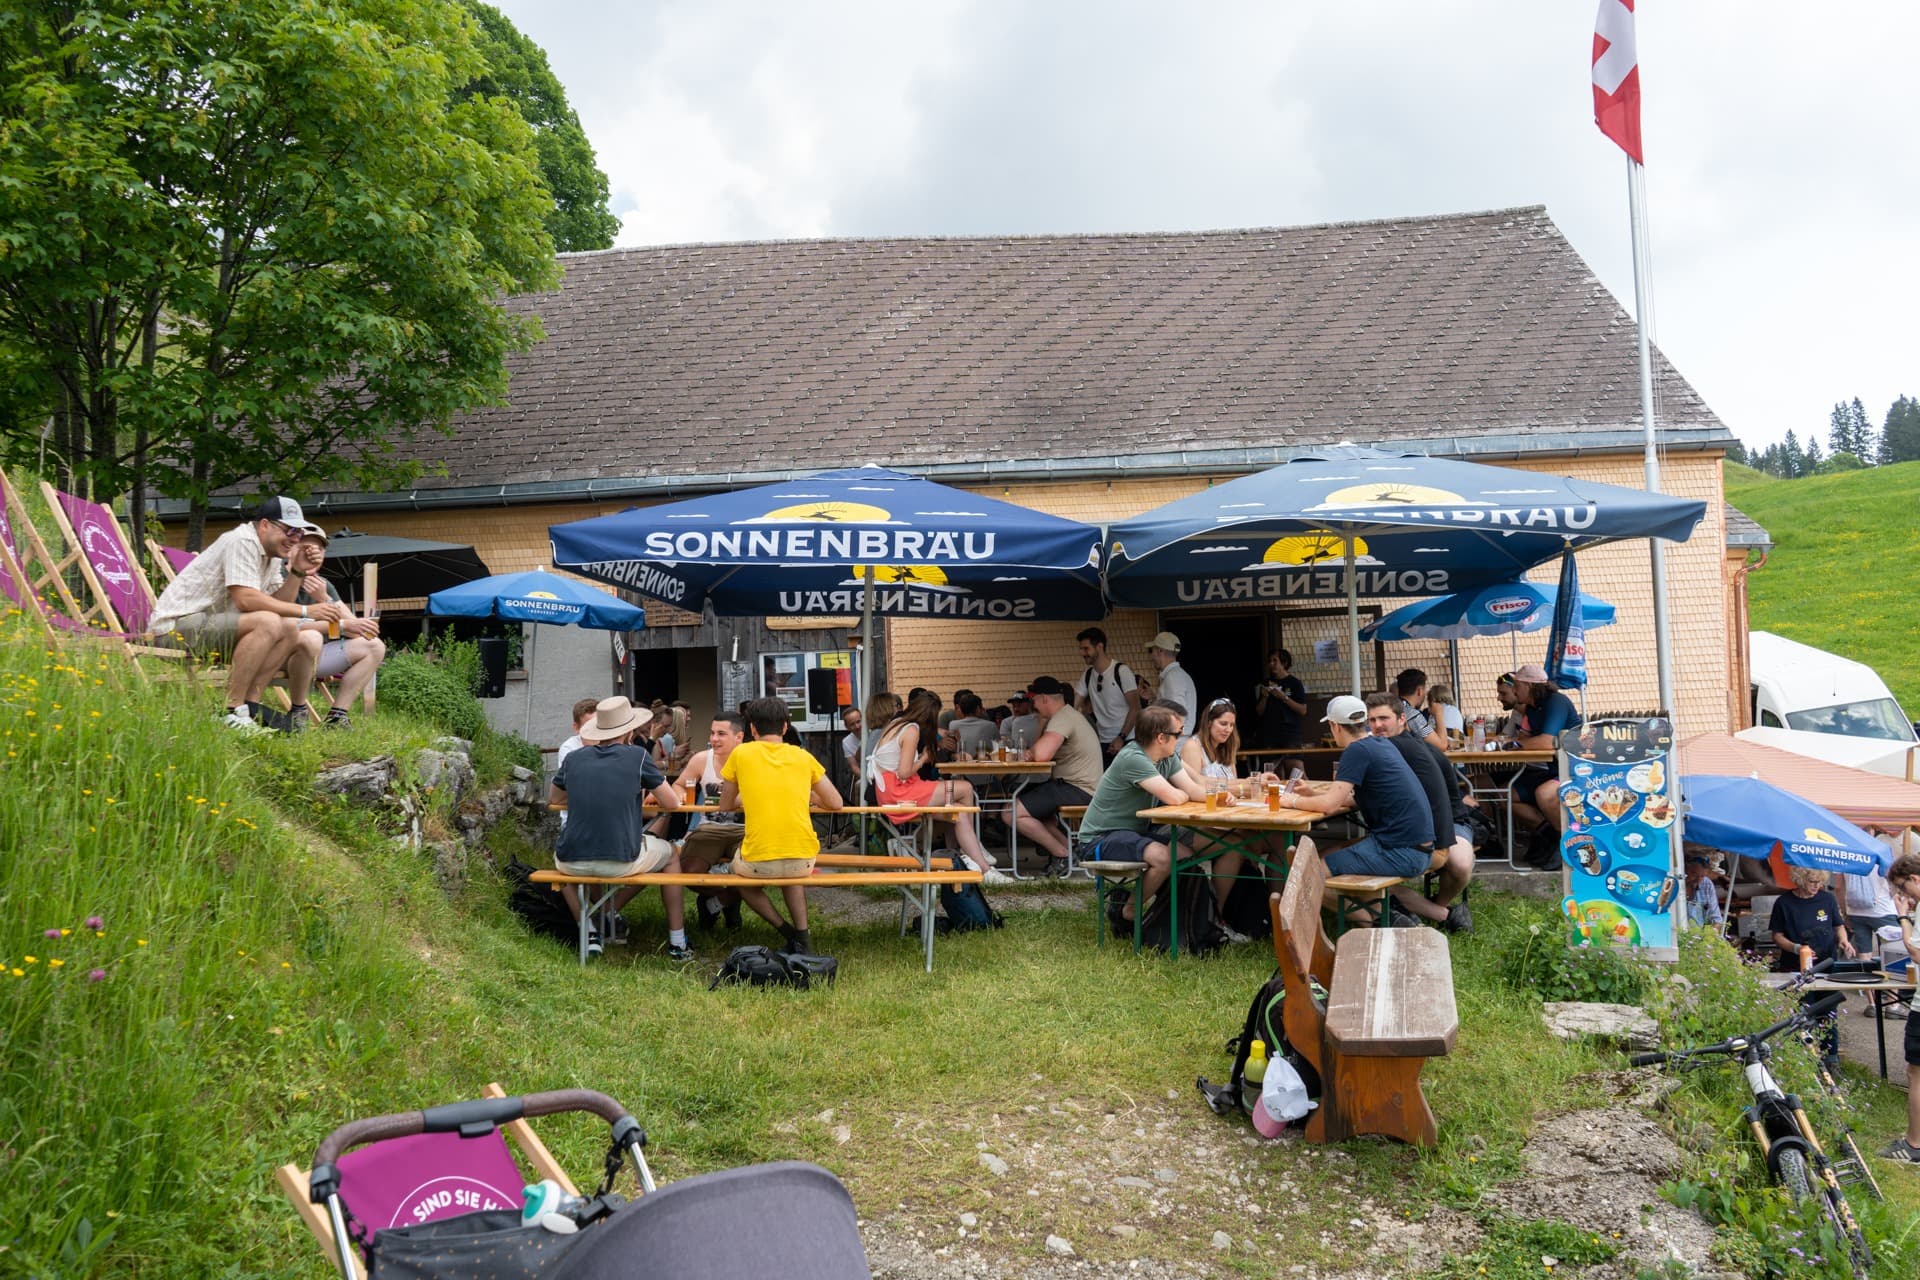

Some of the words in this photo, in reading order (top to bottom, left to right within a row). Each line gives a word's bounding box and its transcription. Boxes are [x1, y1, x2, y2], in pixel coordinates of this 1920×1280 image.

[643, 529, 996, 560] SONNENBRÄU
[505, 600, 580, 613] SONNENBRÄU
[1492, 600, 1530, 612] Frisco
[1602, 723, 1638, 741] Nuii
[1791, 843, 1871, 863] SONNENBRÄU
[413, 1190, 452, 1222] SIND
[455, 1189, 481, 1209] SIE
